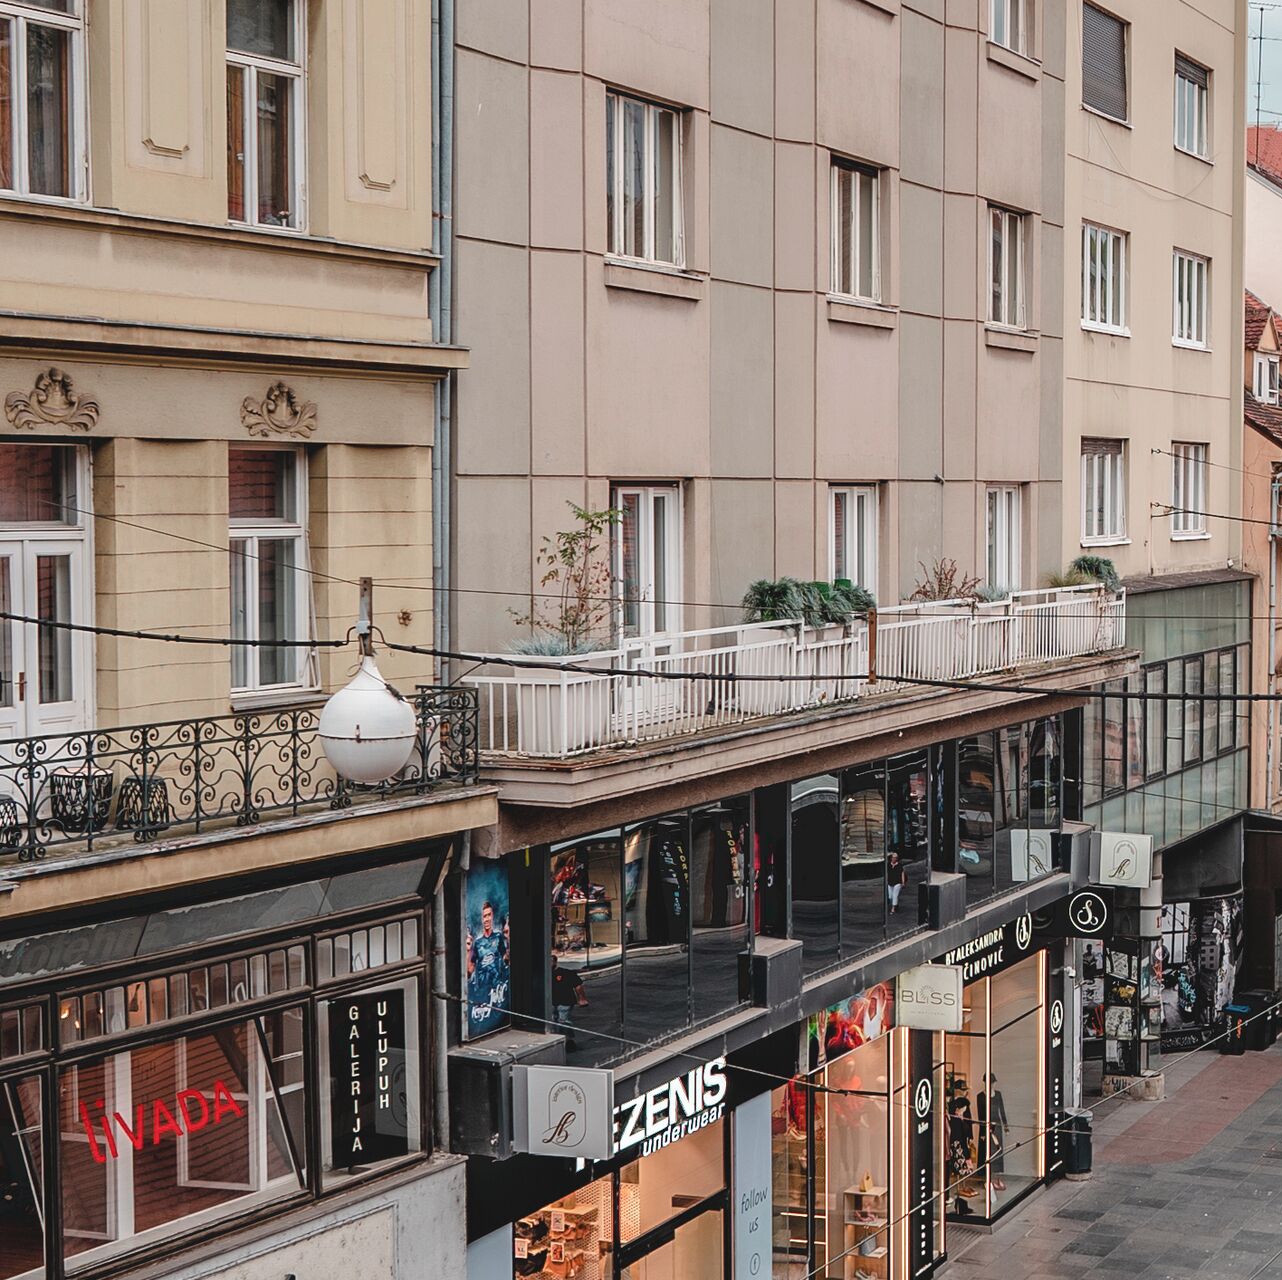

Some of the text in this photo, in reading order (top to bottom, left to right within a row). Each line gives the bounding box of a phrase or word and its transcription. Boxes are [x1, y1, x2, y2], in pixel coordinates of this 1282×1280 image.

[964, 945, 1003, 980] ČINOVIĆ
[377, 1000, 390, 1109] ULUPUH
[349, 1005, 363, 1152] GALERIJA
[642, 1102, 726, 1157] underwear
[741, 1186, 768, 1214] follow
[749, 1217, 759, 1233] us
